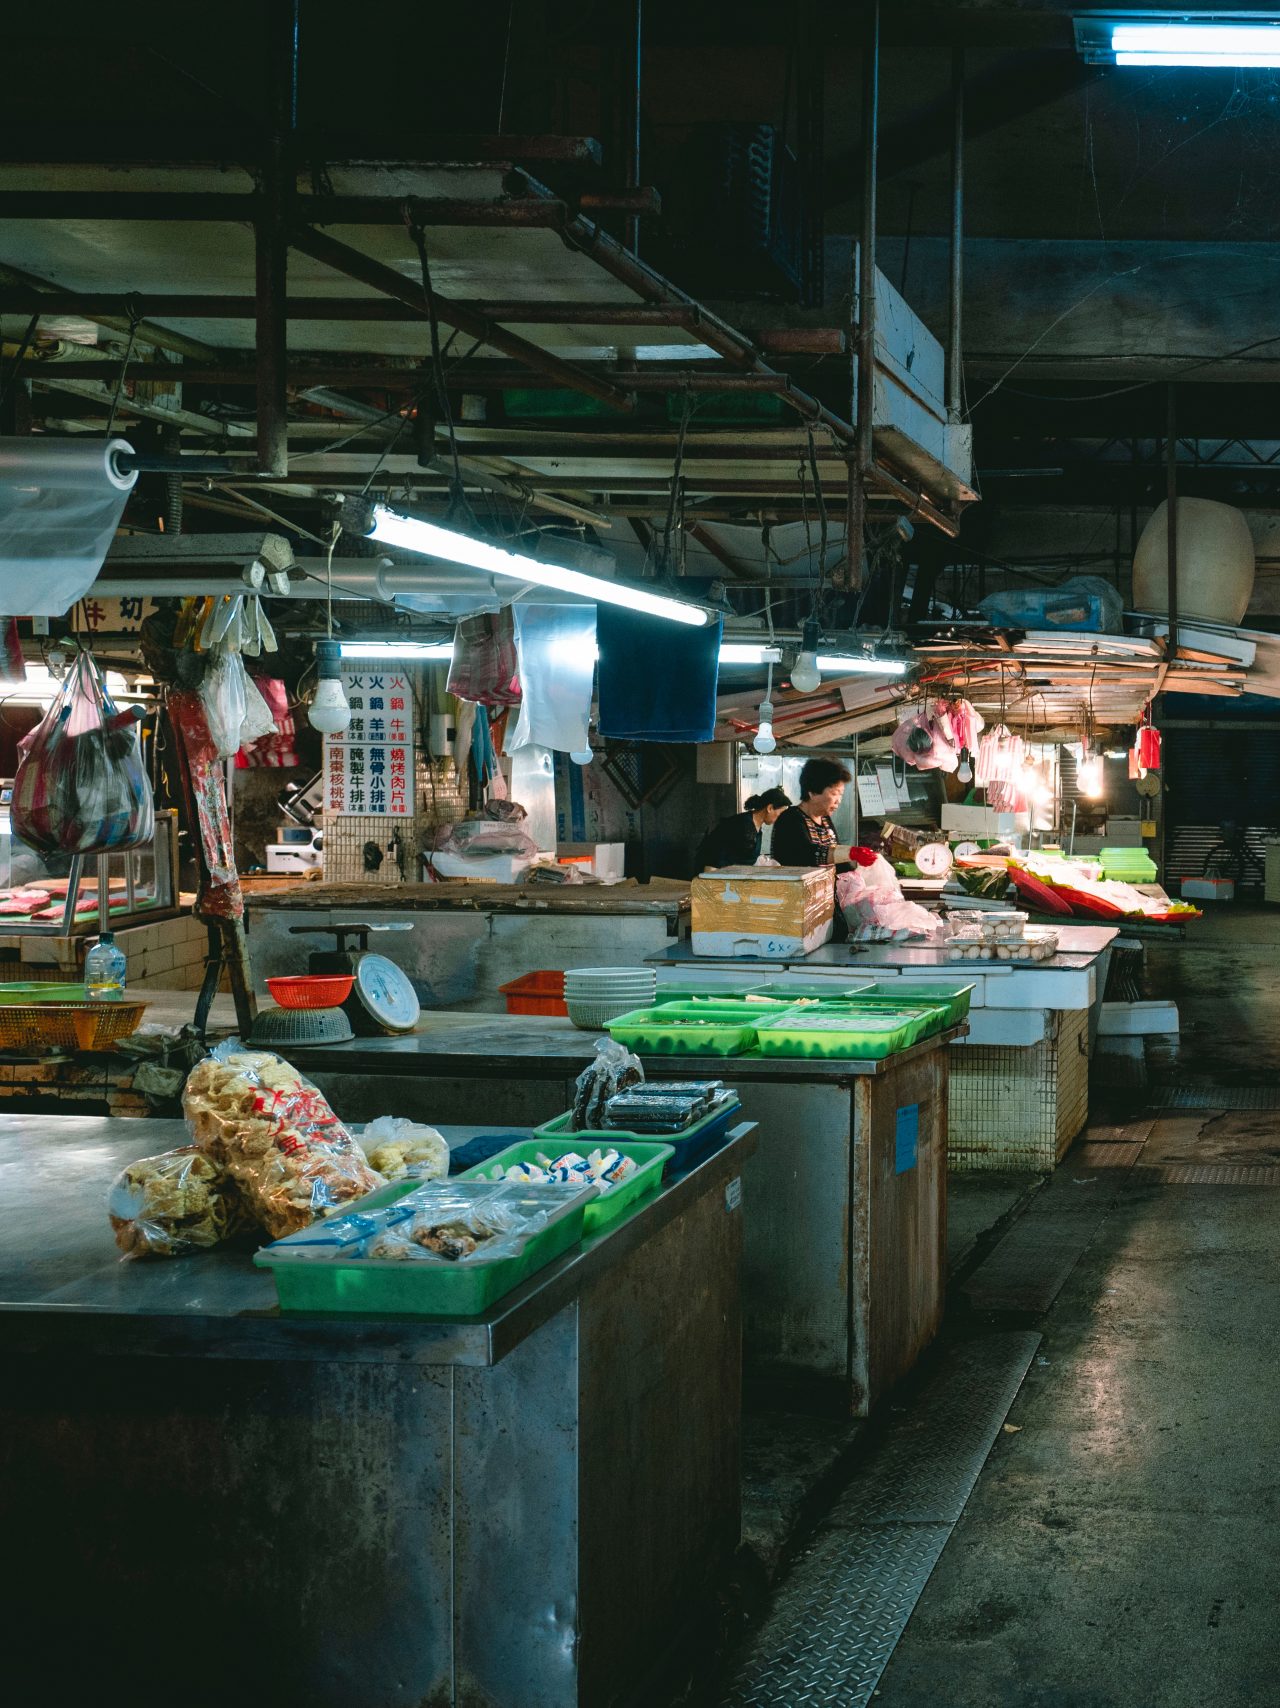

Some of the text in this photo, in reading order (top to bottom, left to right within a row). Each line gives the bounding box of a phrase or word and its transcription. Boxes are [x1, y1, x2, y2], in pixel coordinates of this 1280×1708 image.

[369, 675, 385, 731] 火鍋羊
[389, 676, 405, 731] 火鍋牛
[369, 747, 386, 804] 無骨小排
[390, 748, 406, 804] 燒烤肉片
